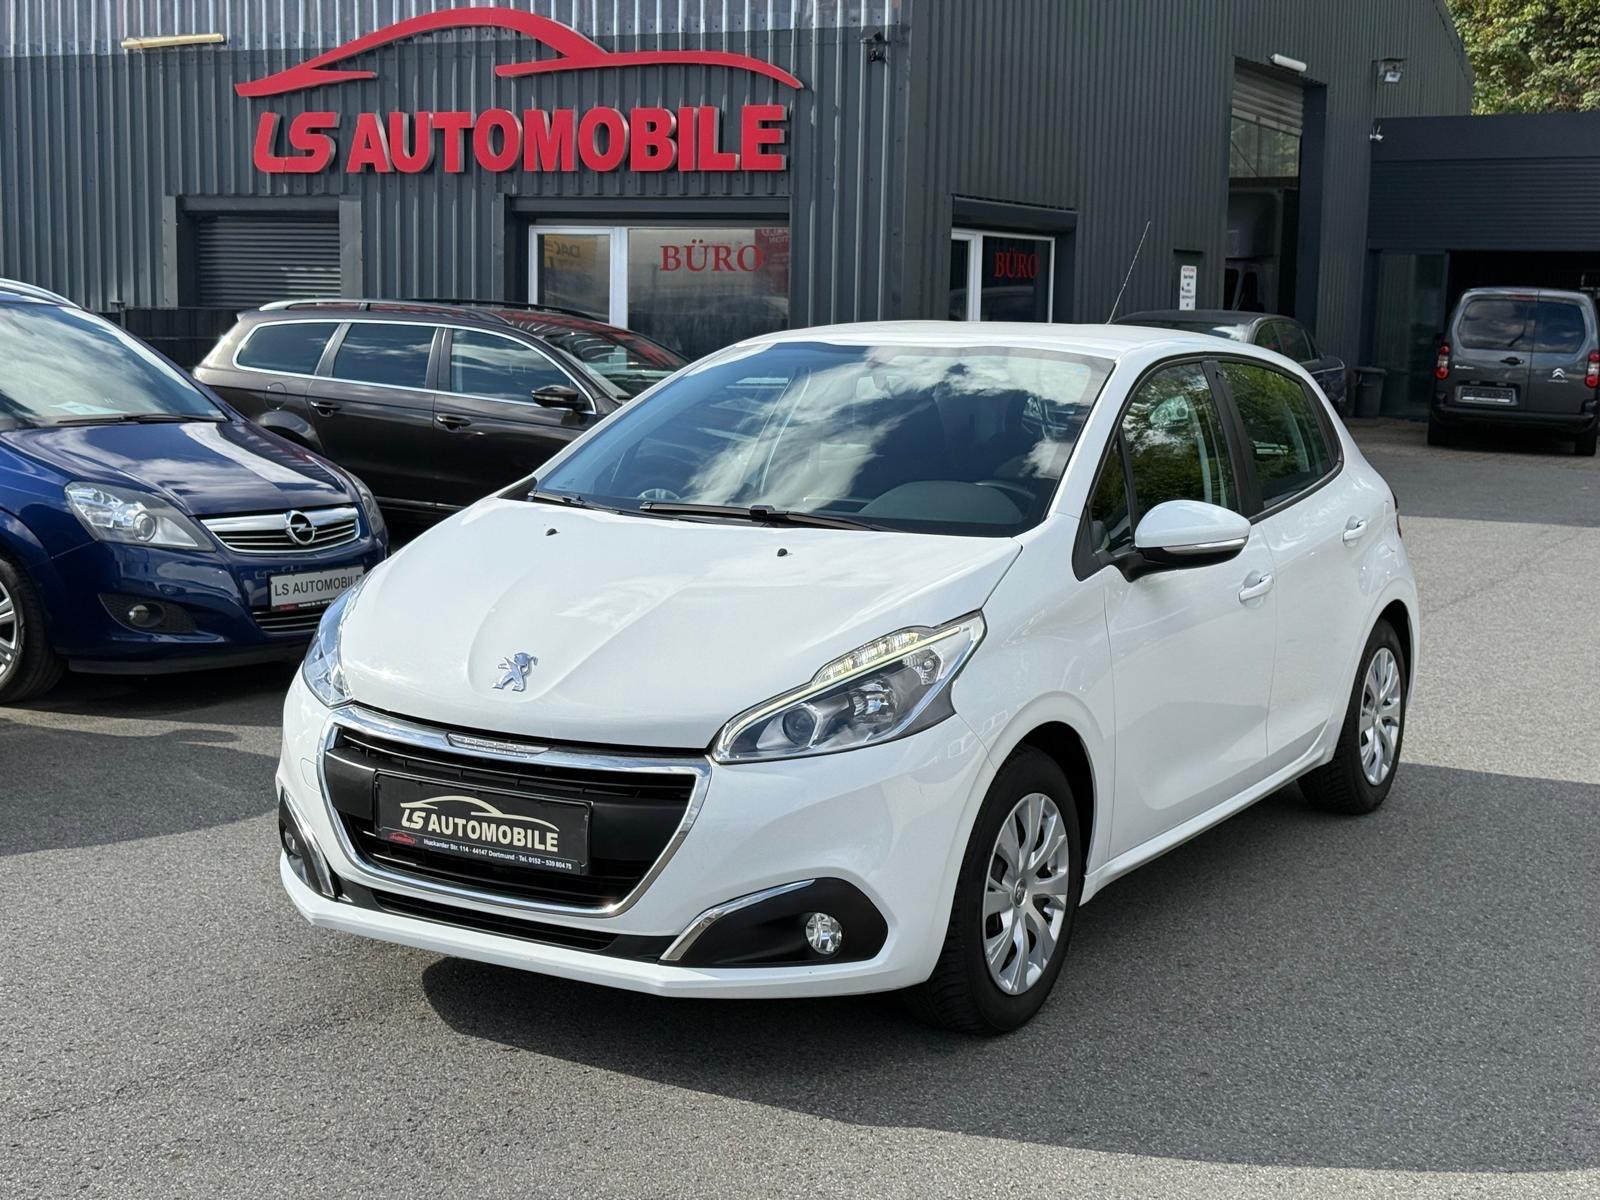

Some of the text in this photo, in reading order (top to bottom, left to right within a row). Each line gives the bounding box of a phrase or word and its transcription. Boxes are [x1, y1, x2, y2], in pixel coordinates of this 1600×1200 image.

[253, 104, 788, 173] LS AUTOMOBILE
[660, 239, 765, 272] BÜRO
[993, 248, 1040, 279] BÜRO
[274, 583, 290, 597] LS
[401, 808, 428, 830] LS
[427, 813, 559, 852] AUTOMOBILE
[472, 847, 488, 856] 44147
[488, 850, 515, 860] Dortmund
